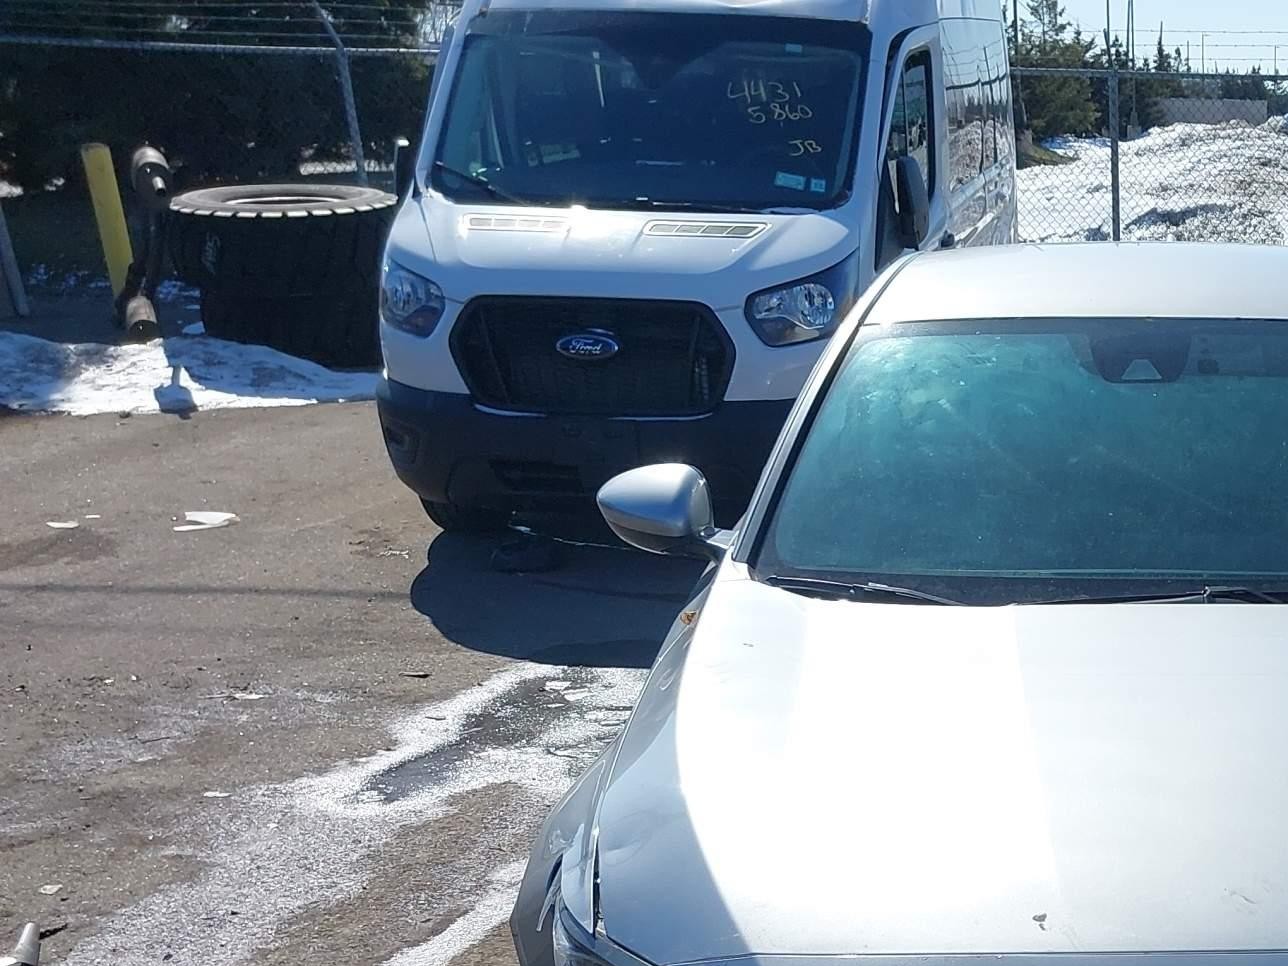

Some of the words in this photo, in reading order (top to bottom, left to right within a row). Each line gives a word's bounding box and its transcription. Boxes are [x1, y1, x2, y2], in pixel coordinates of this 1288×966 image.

[727, 80, 802, 104] 4431
[746, 103, 814, 125] 5860
[568, 338, 604, 355] Ford
